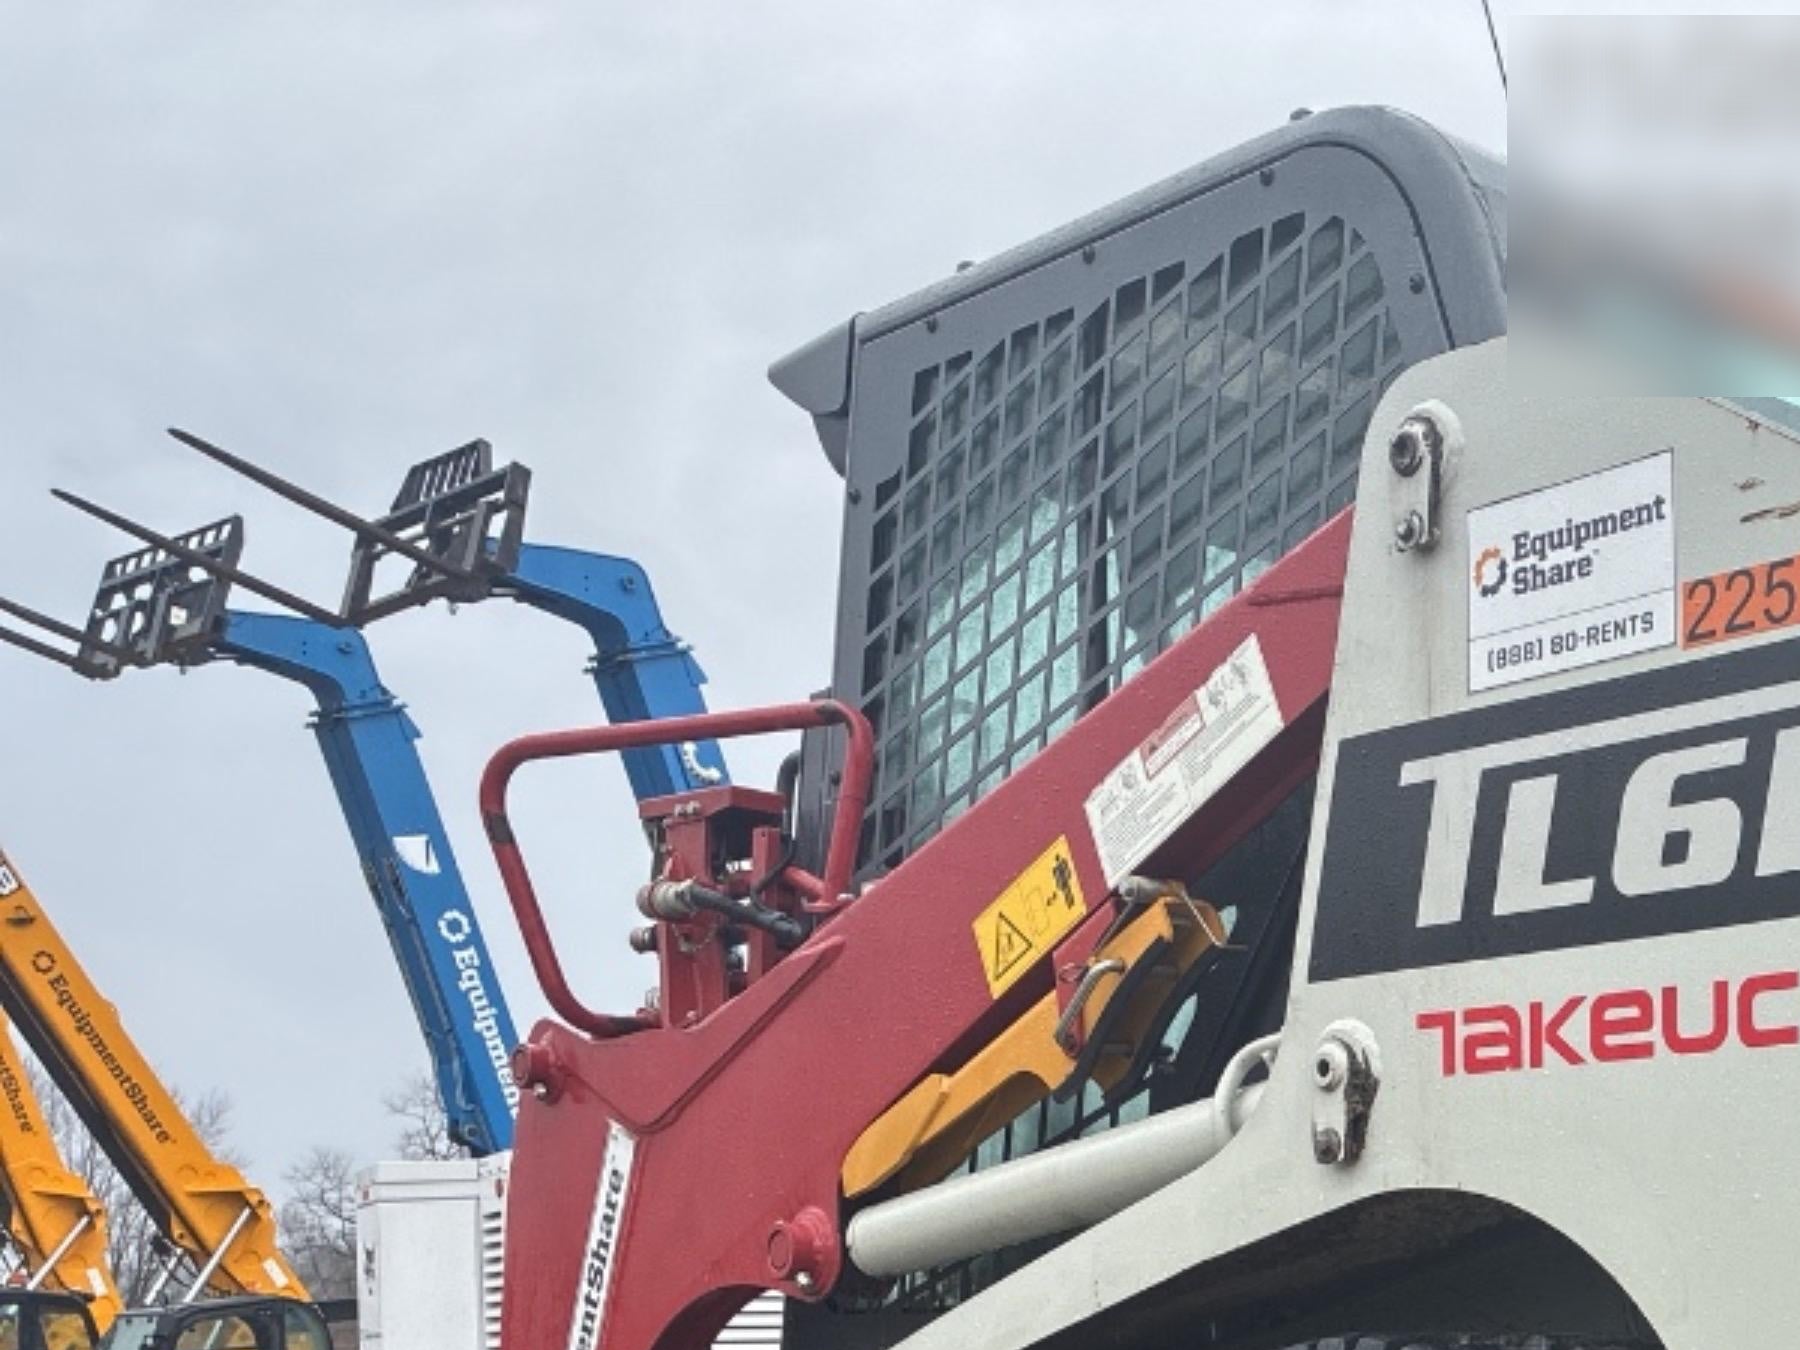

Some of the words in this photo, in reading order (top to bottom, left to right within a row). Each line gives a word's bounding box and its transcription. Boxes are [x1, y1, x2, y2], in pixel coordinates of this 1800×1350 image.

[1511, 494, 1666, 561] Equipment
[1512, 554, 1594, 596] Share
[48, 973, 170, 1145] EquipmentShare
[452, 945, 520, 1120] Equipmen
